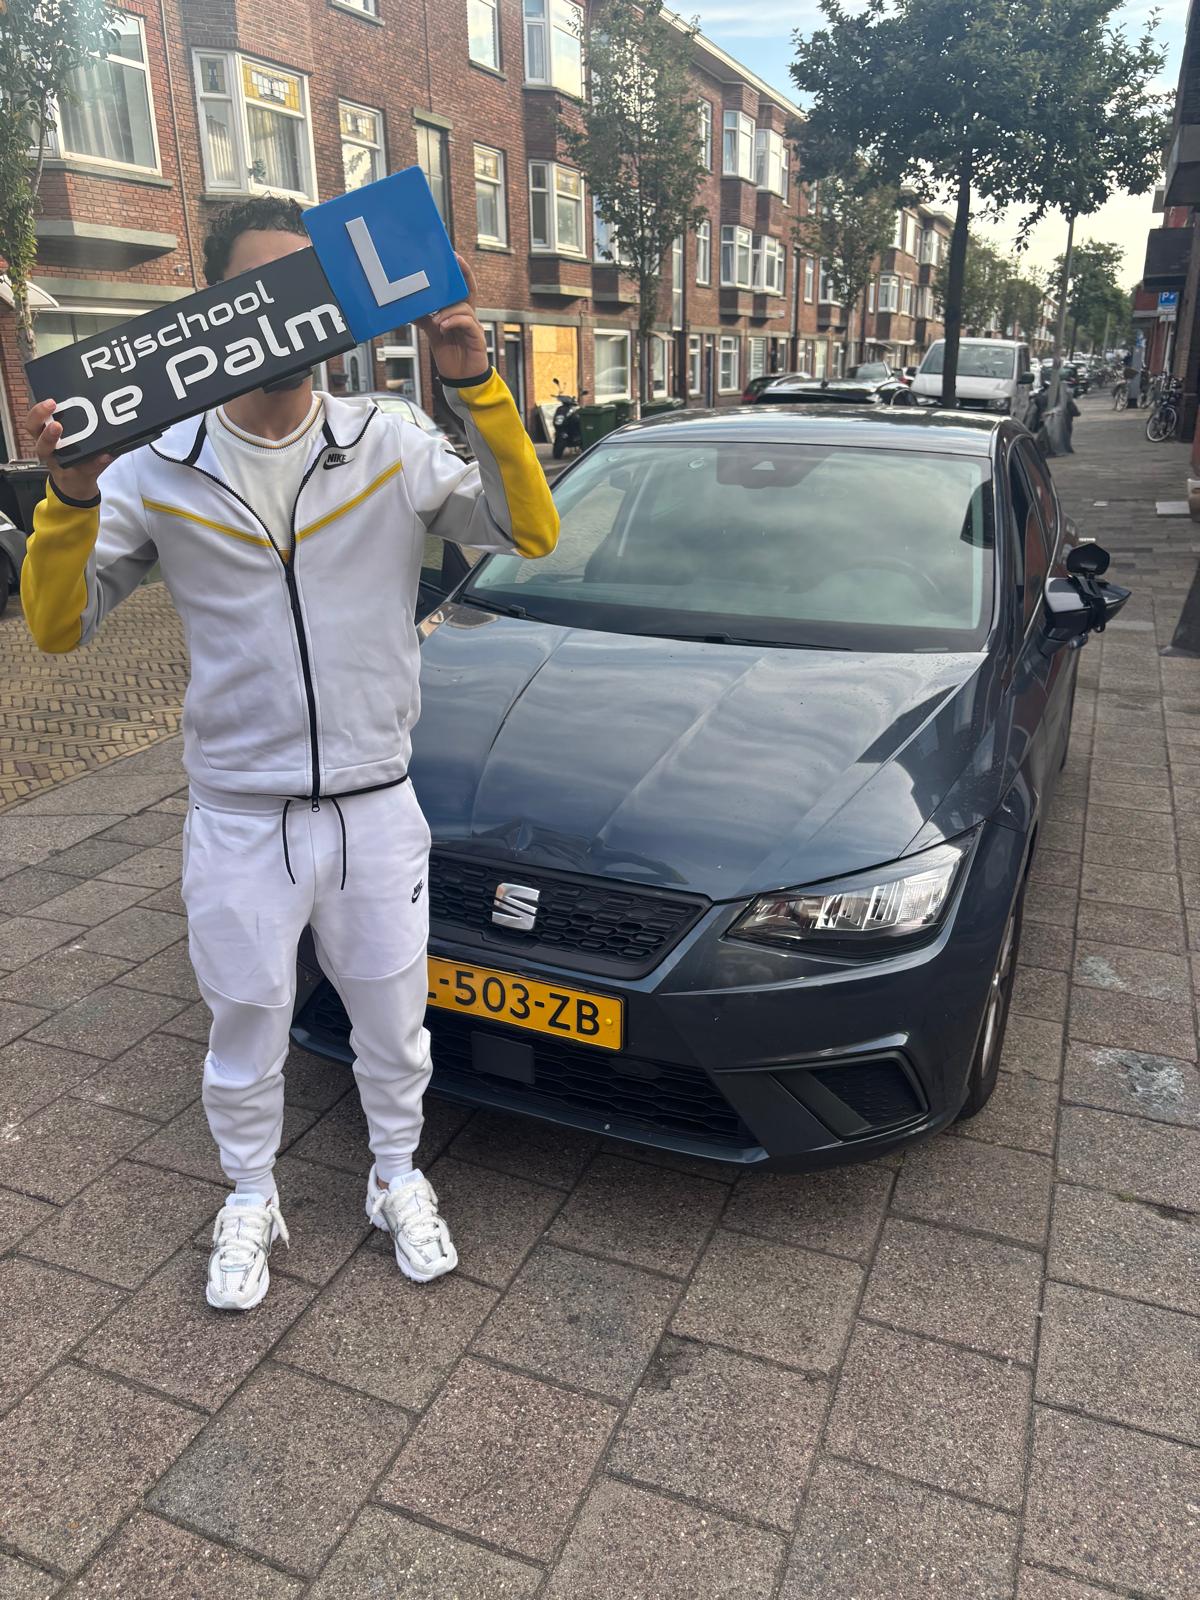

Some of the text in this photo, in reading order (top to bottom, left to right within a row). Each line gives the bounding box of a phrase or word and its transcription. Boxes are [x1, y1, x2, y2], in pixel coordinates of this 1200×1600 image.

[345, 216, 430, 307] L
[81, 280, 275, 378] Rijschool
[45, 303, 347, 449] De Palm
[326, 453, 347, 463] NIKE
[428, 970, 600, 1036] -503-ZB
